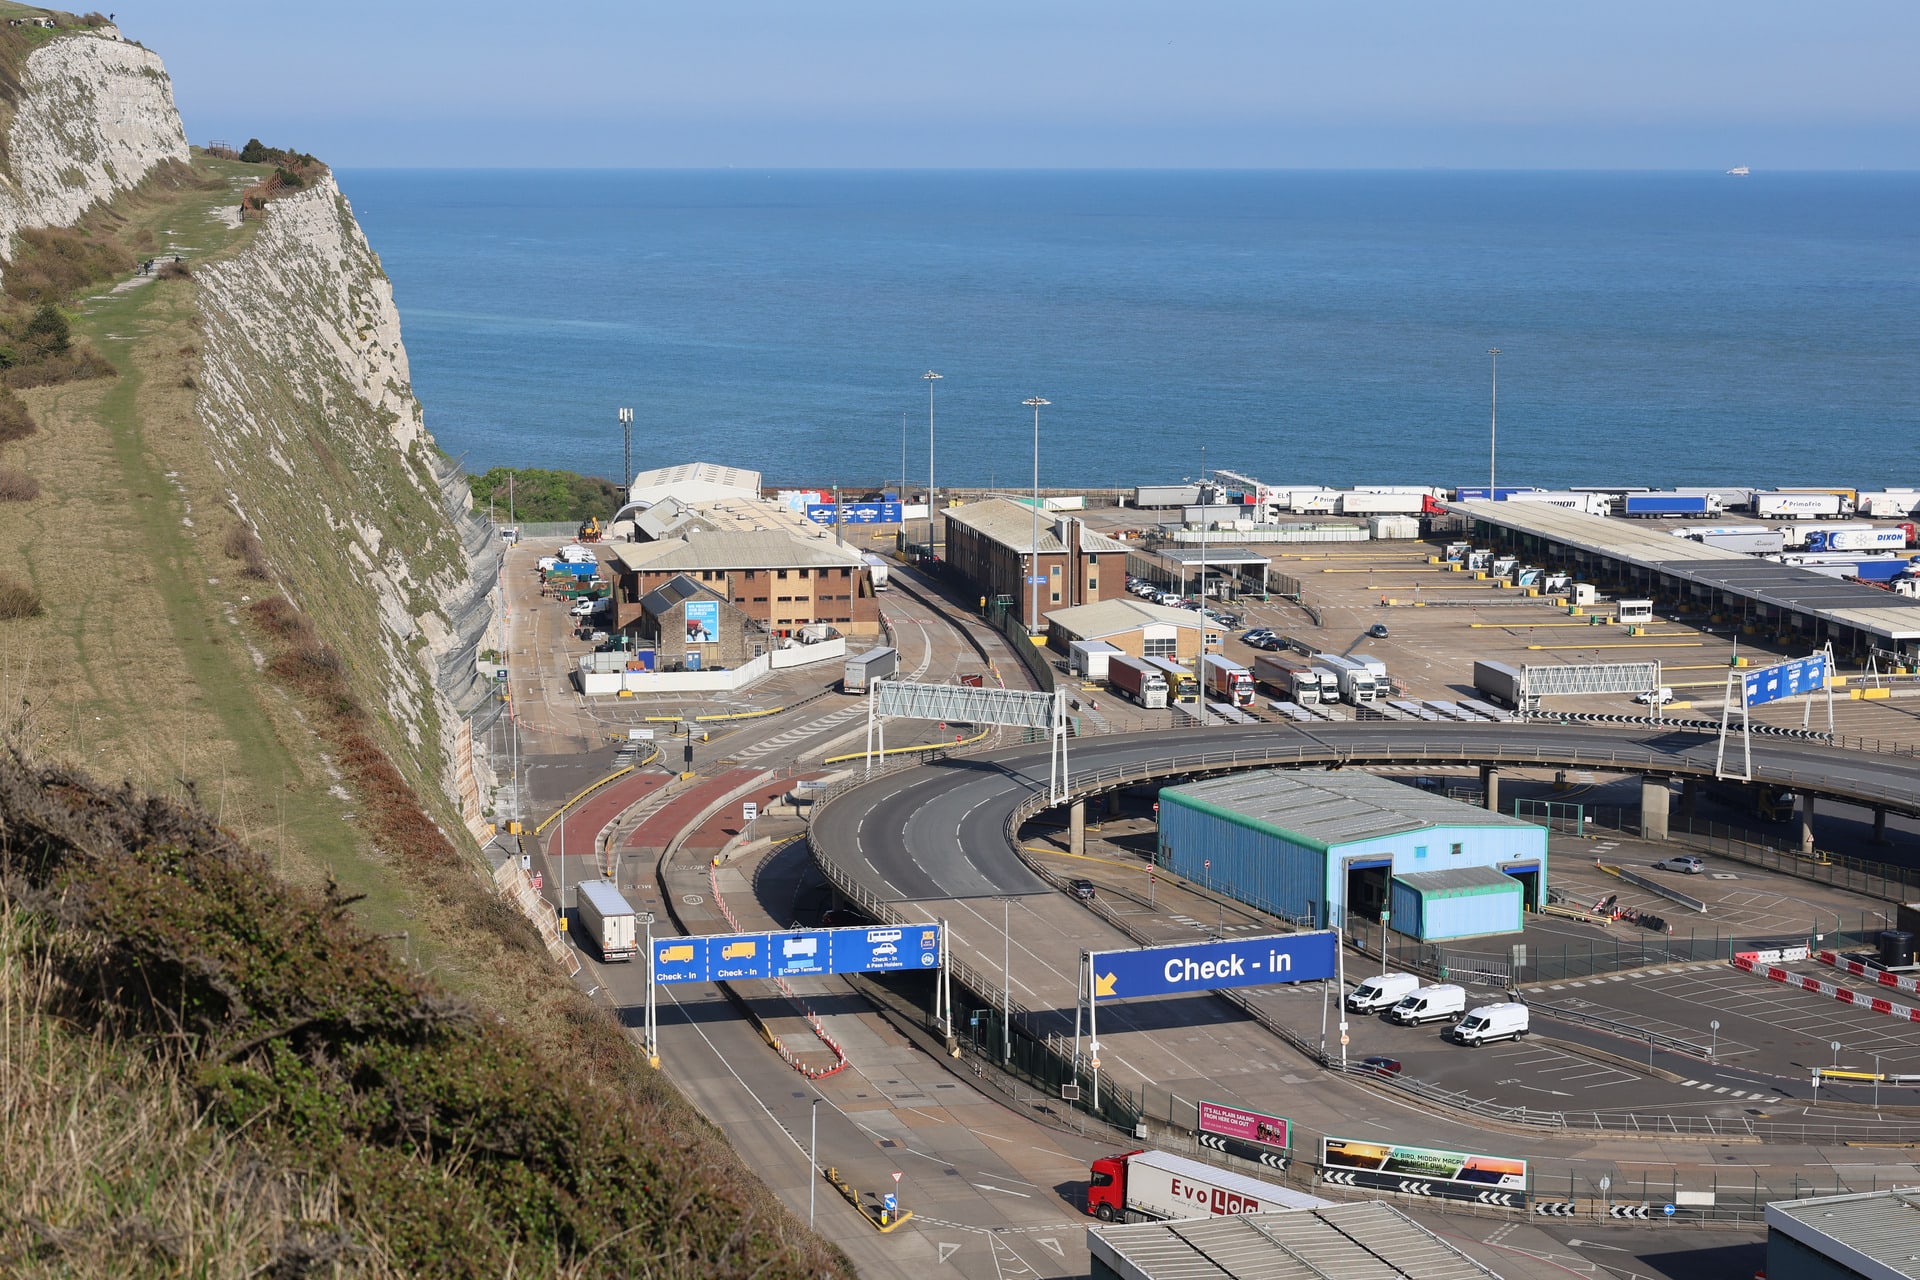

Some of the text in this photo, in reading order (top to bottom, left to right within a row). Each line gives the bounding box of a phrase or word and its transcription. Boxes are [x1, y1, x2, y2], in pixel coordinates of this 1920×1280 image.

[1164, 953, 1245, 983] Check
[1269, 949, 1291, 973] in
[656, 973, 682, 981] Check
[718, 969, 743, 977] Check
[749, 968, 757, 976] In
[1203, 1106, 1213, 1114] IT'S
[1221, 1111, 1236, 1119] PLAIN
[1236, 1114, 1255, 1123] SAILING
[1203, 1112, 1218, 1120] FROM
[1217, 1115, 1231, 1123] HERE
[1380, 1150, 1399, 1158] EARLY
[1417, 1154, 1441, 1162] MIDDAY
[1409, 1159, 1428, 1167] NIGHT
[1429, 1162, 1447, 1170] OWL?
